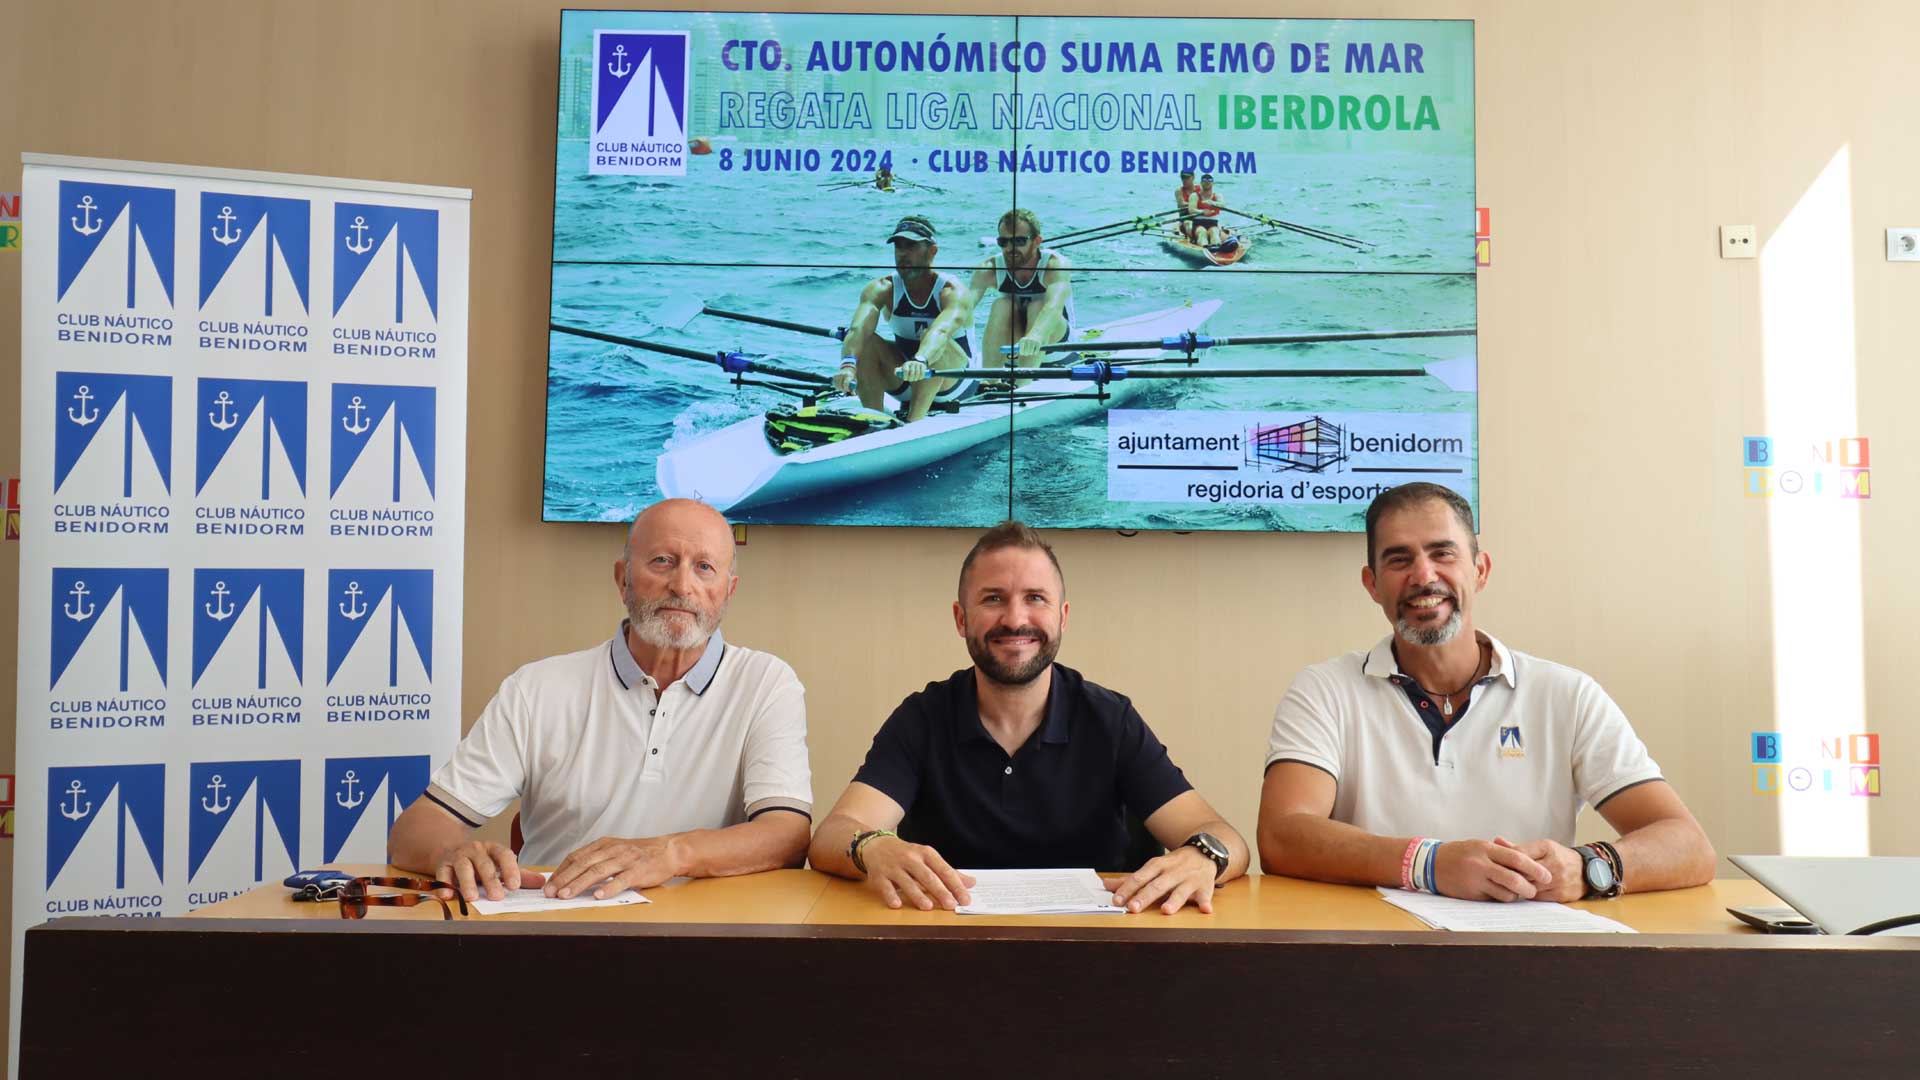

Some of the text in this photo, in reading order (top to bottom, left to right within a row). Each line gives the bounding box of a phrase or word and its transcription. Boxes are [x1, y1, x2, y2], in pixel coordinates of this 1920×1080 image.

[722, 33, 1424, 73] CTO. AUTONÓMICO SUMA REMO DE MAR
[720, 91, 1440, 130] REGATA LIGA NACIONAL IBERDROLA
[596, 141, 682, 153] CLUB NÁUTICO
[596, 156, 681, 167] BENIDORM
[719, 145, 1256, 173] 8 JUNIO 2024 CLUB NÁUTICO BENIDORM
[57, 313, 173, 331] CLUB NÁUTICO
[199, 321, 308, 337] CLUB NÁUTICO
[57, 330, 172, 346] BENIDORM
[332, 328, 437, 344] CLUB NÁUTICO
[200, 336, 307, 352] BENIDORM
[333, 343, 436, 358] BENIDORM
[1118, 433, 1463, 453] ajuntament benidorm
[1188, 481, 1283, 502] regidoria
[54, 504, 170, 518] CLUB NÁUTICO
[195, 506, 305, 520] CLUB NÁUTICO
[330, 508, 434, 522] CLUB NÁUTICO
[54, 521, 169, 533] BENIDORM
[196, 522, 304, 535] BENIDORM
[330, 524, 433, 536] BENIDORM
[50, 697, 166, 713] CLUB NÁUTICO
[191, 695, 302, 710] CLUB NÁUTICO
[326, 693, 431, 707] CLUB NÁUTICO
[50, 714, 165, 729] BENIDORM
[192, 712, 301, 726] BENIDORM
[327, 709, 430, 722] BENIDORM
[46, 895, 162, 913] CLUB NÁUTICO
[188, 892, 228, 905] CLUB
